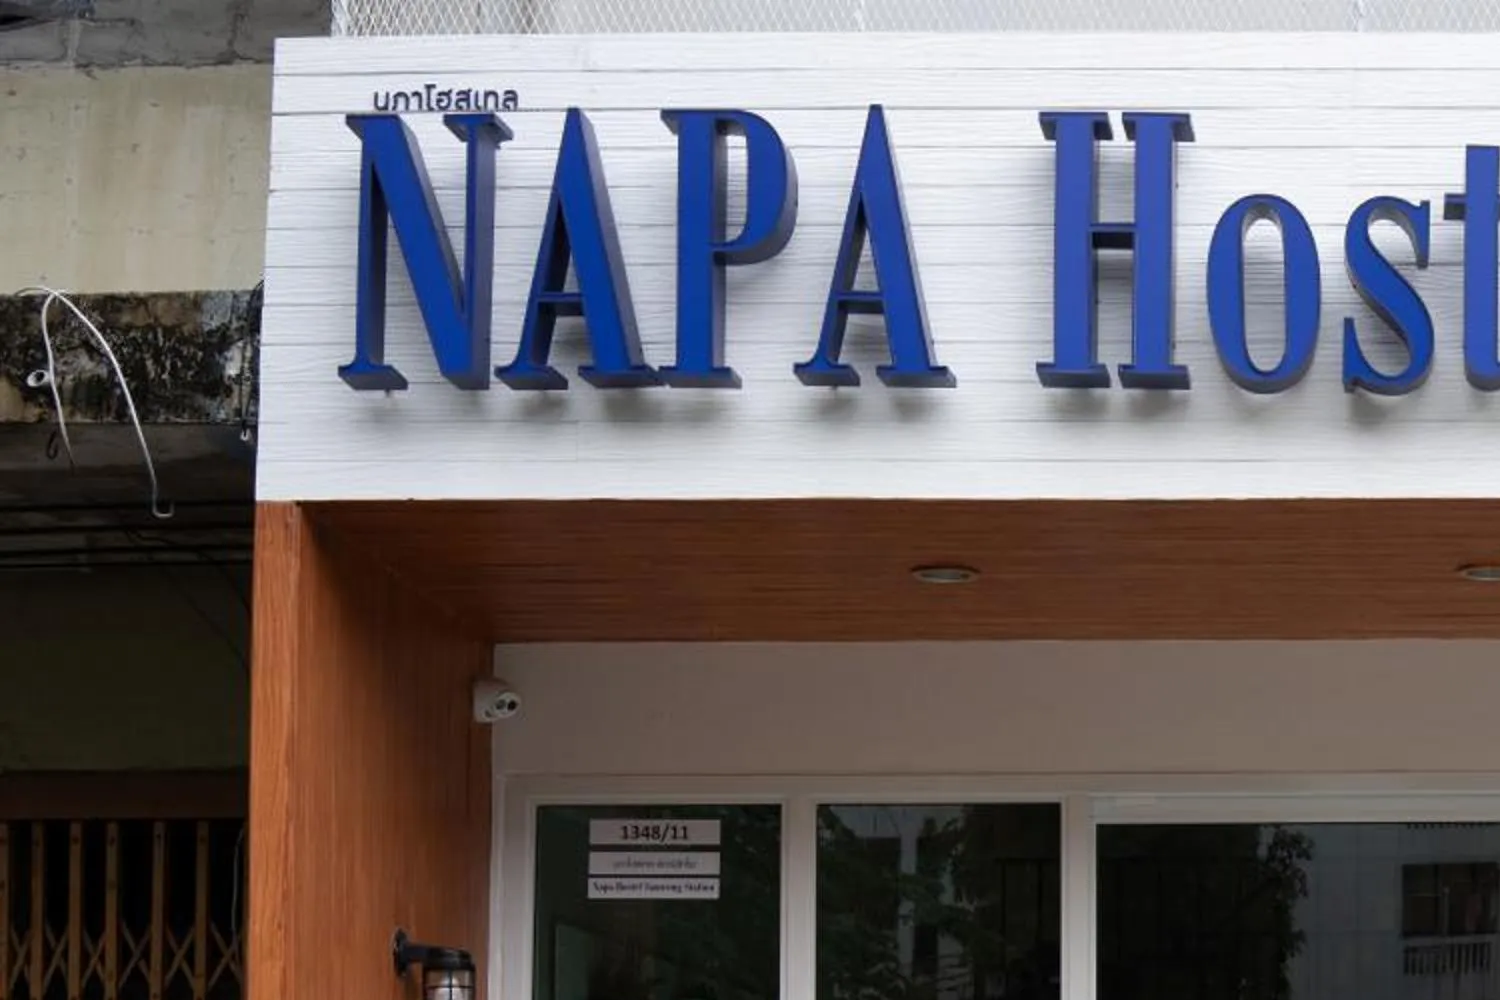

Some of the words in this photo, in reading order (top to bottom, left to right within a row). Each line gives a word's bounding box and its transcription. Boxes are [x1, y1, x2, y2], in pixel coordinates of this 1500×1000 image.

[373, 83, 519, 112] นภาโฮสเทล
[338, 103, 957, 392] NAPA
[620, 824, 689, 842] 1348/11
